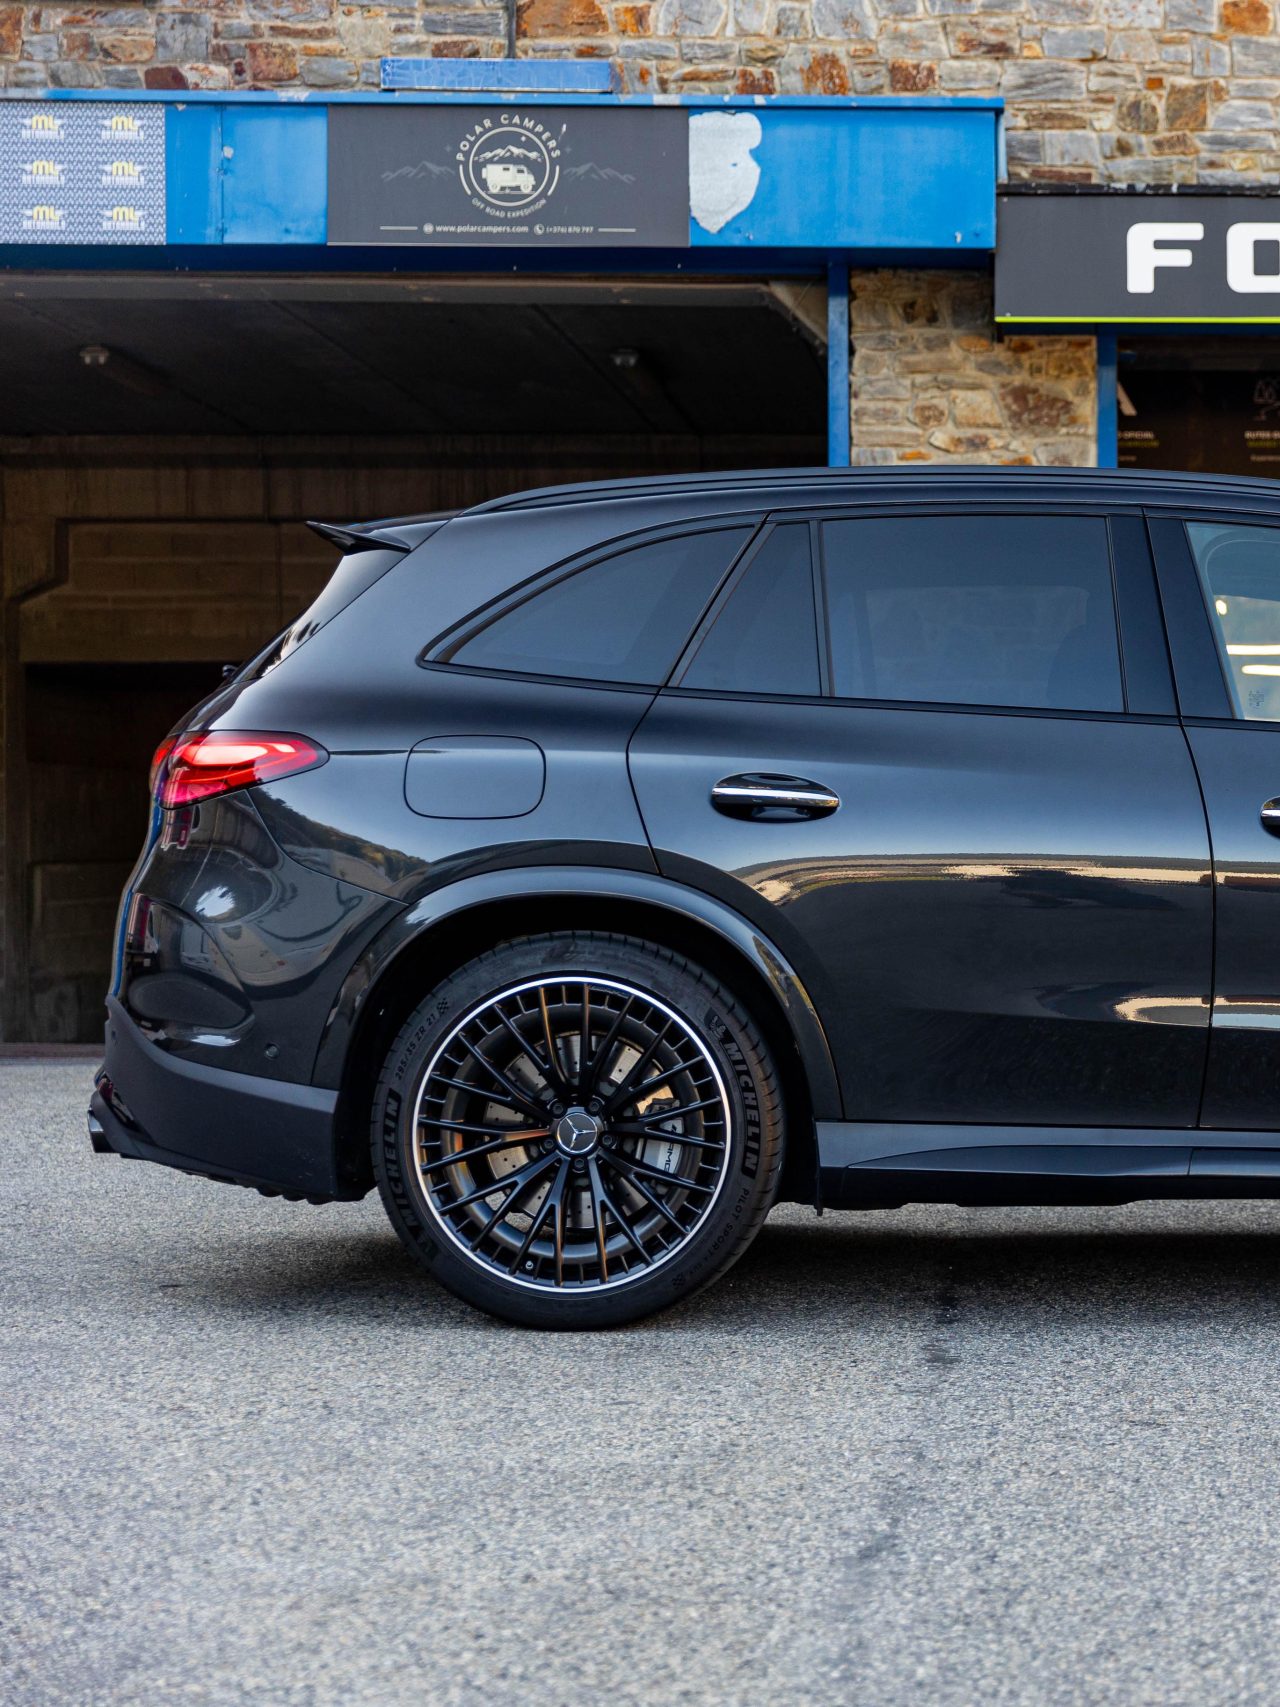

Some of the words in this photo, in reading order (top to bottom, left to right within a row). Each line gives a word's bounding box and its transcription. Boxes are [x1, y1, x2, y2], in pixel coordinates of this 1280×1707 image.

[456, 118, 493, 161] POLAR
[501, 114, 561, 158] CAMPERS
[471, 197, 485, 209] OFF
[485, 206, 505, 218] ROAD
[436, 224, 529, 234] www.polarcampers.com
[724, 1041, 761, 1174] MICHELIN
[383, 1094, 420, 1228] MICHELIN
[732, 1187, 750, 1220] PILOT
